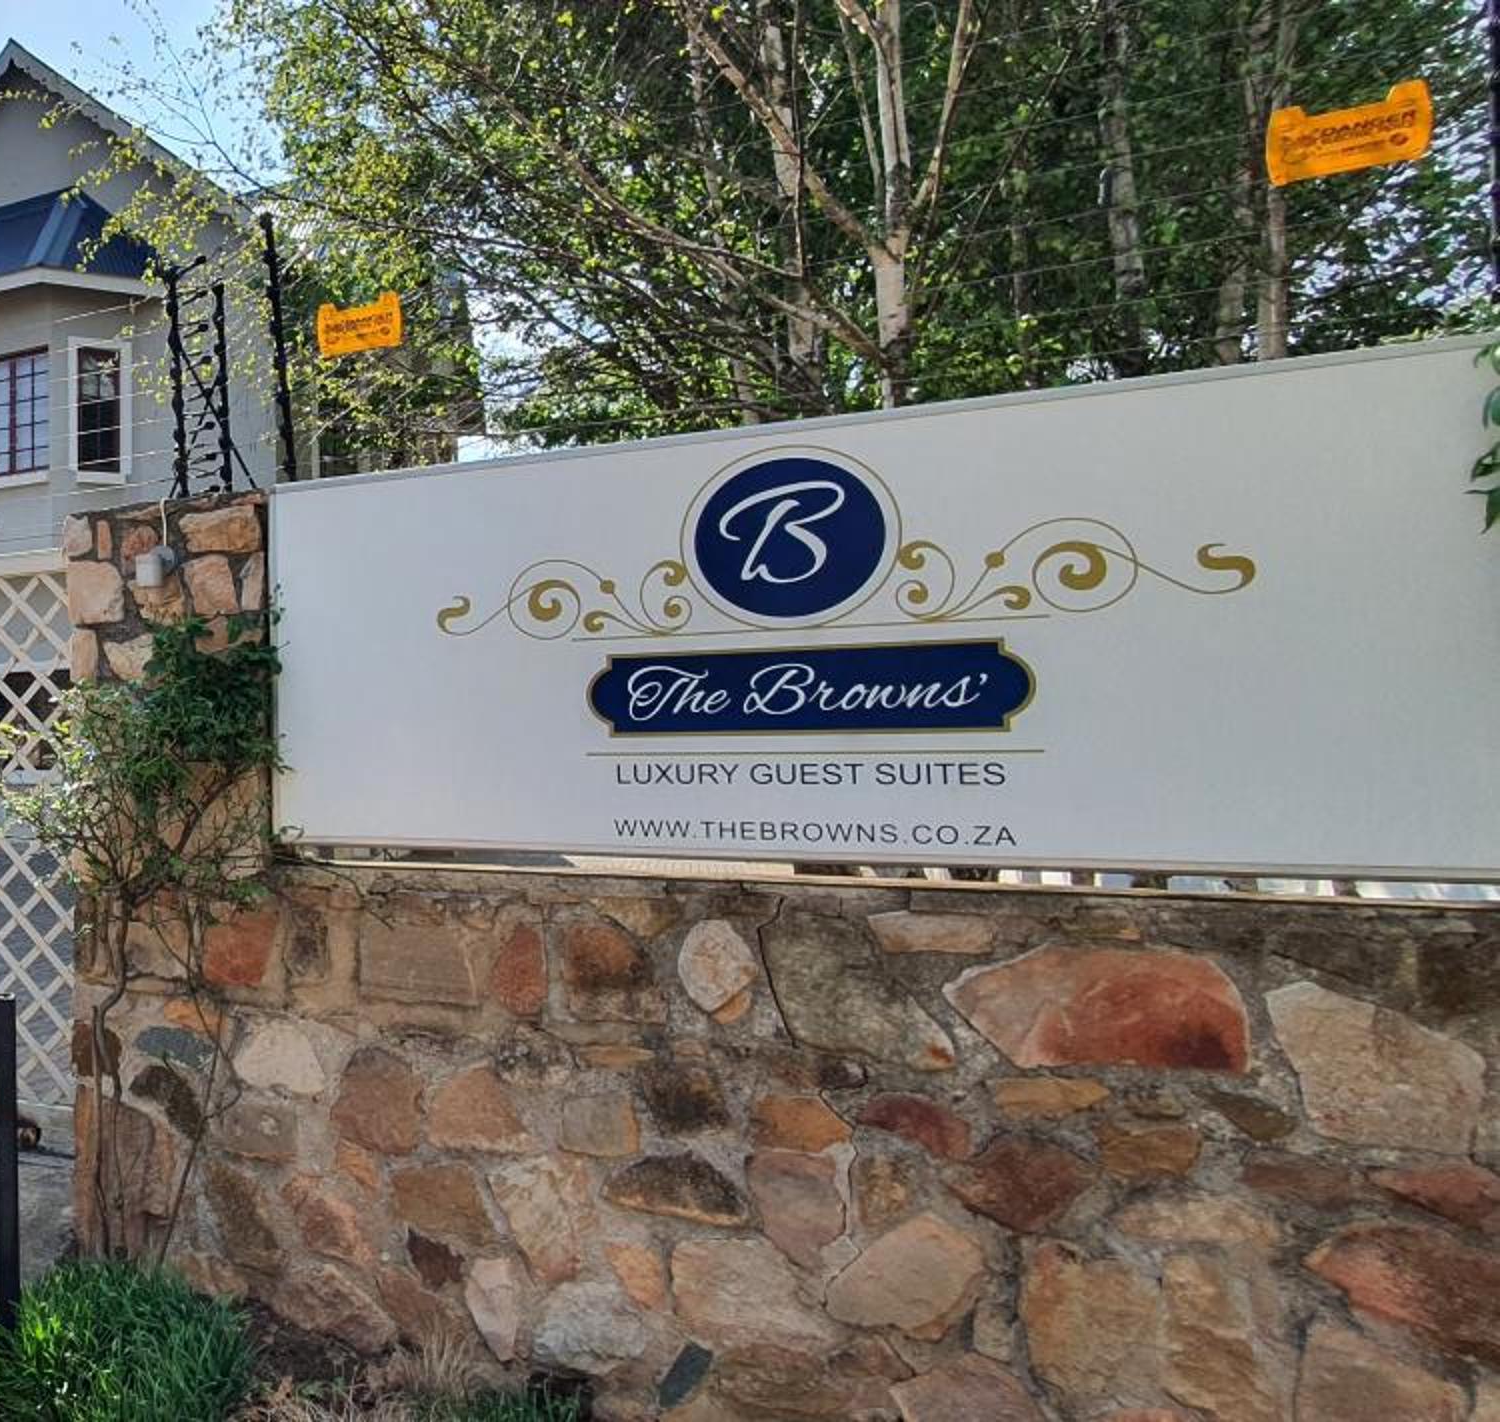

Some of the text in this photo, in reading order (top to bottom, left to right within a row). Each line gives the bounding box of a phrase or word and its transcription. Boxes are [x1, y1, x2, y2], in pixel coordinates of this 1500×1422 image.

[719, 480, 845, 583] B
[626, 665, 732, 721] The
[615, 762, 1006, 786] LUXURY GUEST SUITES
[614, 818, 1017, 847] WWW.THEBROWNS.CO.ZA
